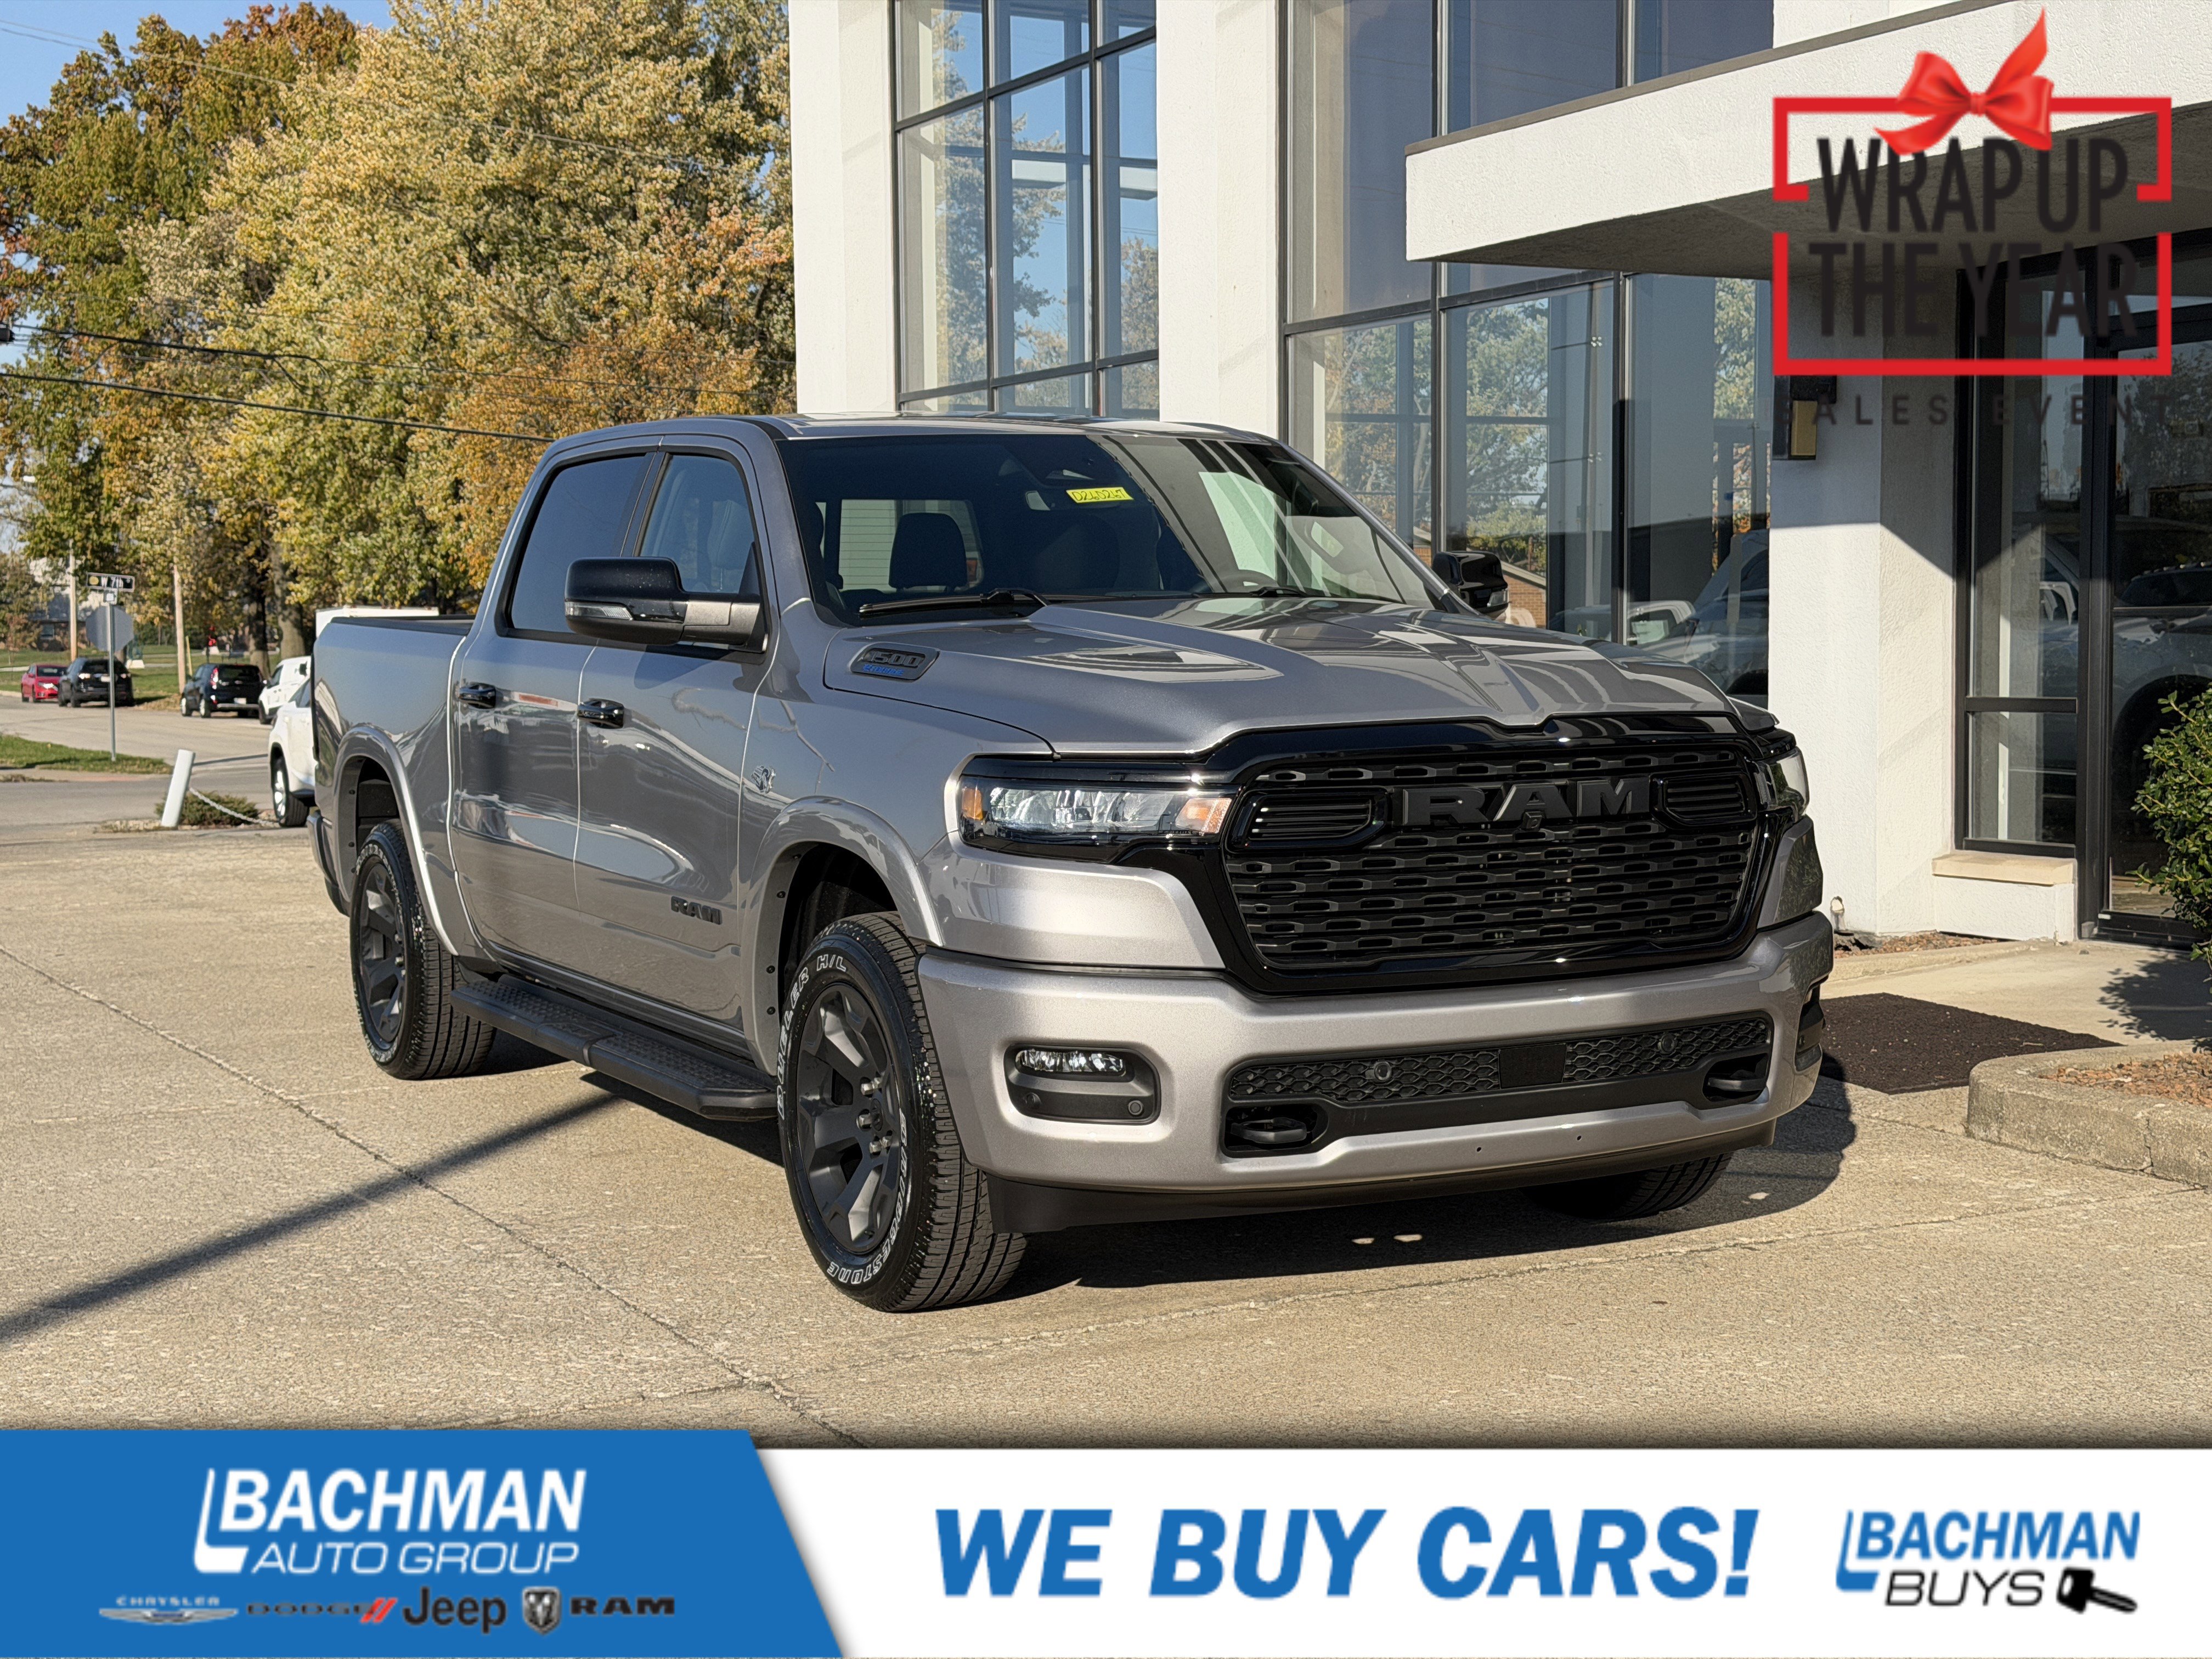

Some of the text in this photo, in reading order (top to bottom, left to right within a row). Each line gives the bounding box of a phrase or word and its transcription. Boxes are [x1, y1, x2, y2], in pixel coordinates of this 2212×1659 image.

[1402, 777, 1650, 825] RAM
[671, 896, 722, 925] RAM
[827, 1107, 907, 1284] BRIDGESTONE
